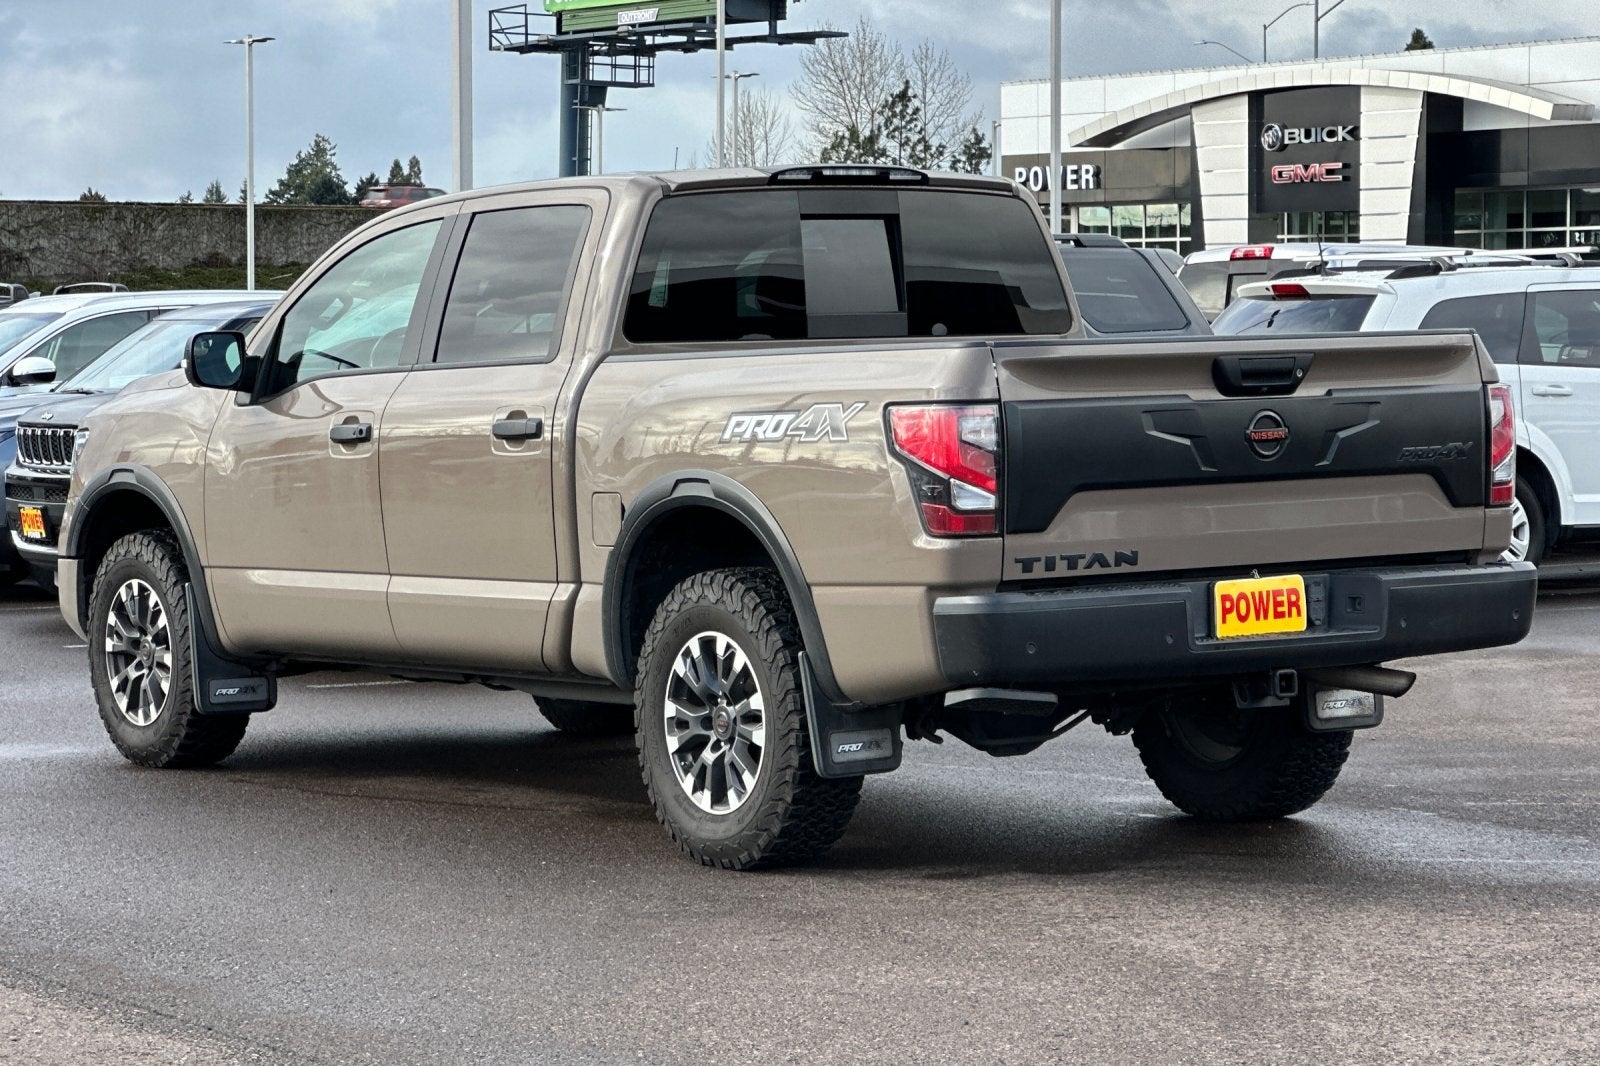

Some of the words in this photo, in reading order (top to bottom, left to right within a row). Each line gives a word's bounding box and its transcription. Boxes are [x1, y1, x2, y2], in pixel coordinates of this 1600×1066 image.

[621, 11, 654, 22] OUTFRONT
[1284, 125, 1354, 144] BUICK
[1271, 162, 1343, 183] GMC
[1251, 431, 1285, 440] NISSAN
[1015, 550, 1139, 573] TITAN
[1220, 588, 1302, 624] POWER
